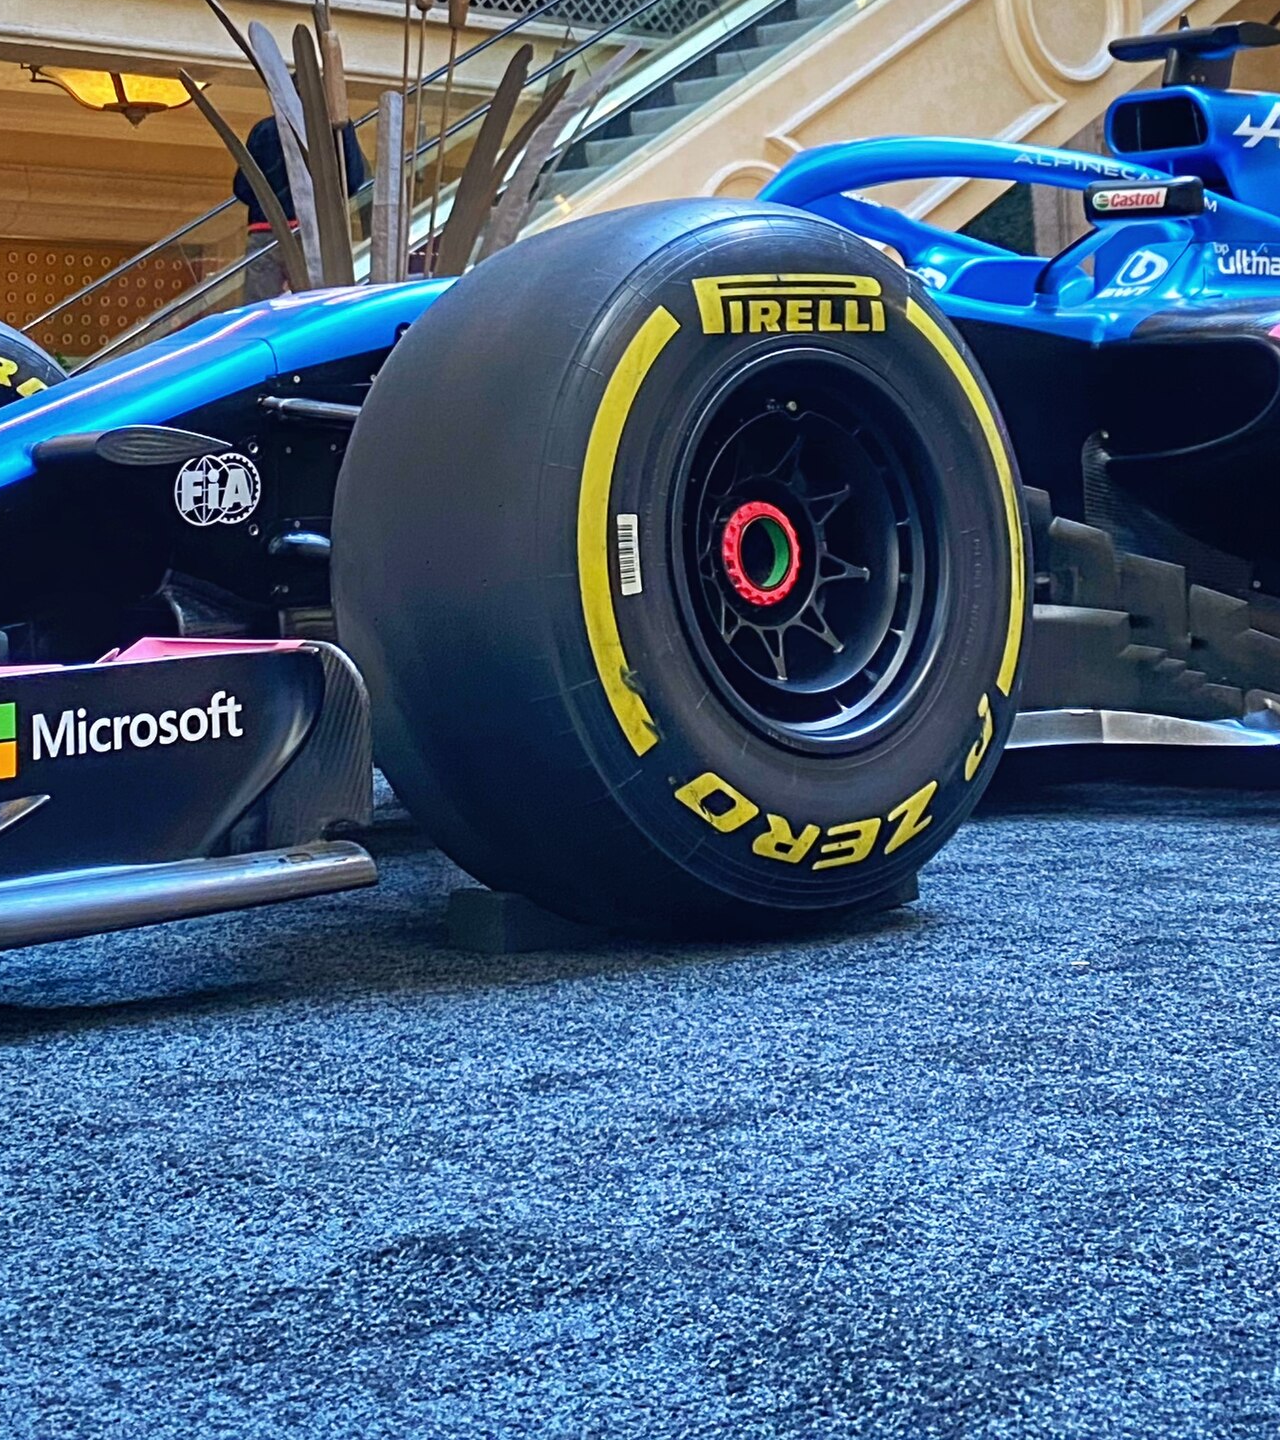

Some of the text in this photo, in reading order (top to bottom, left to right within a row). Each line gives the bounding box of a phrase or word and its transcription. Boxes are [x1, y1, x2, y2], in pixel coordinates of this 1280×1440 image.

[1110, 191, 1161, 208] Castrol
[692, 273, 886, 334] PIRELLI
[1096, 286, 1152, 299] BWT
[31, 690, 244, 761] Microsoft
[674, 771, 938, 871] ZERO
